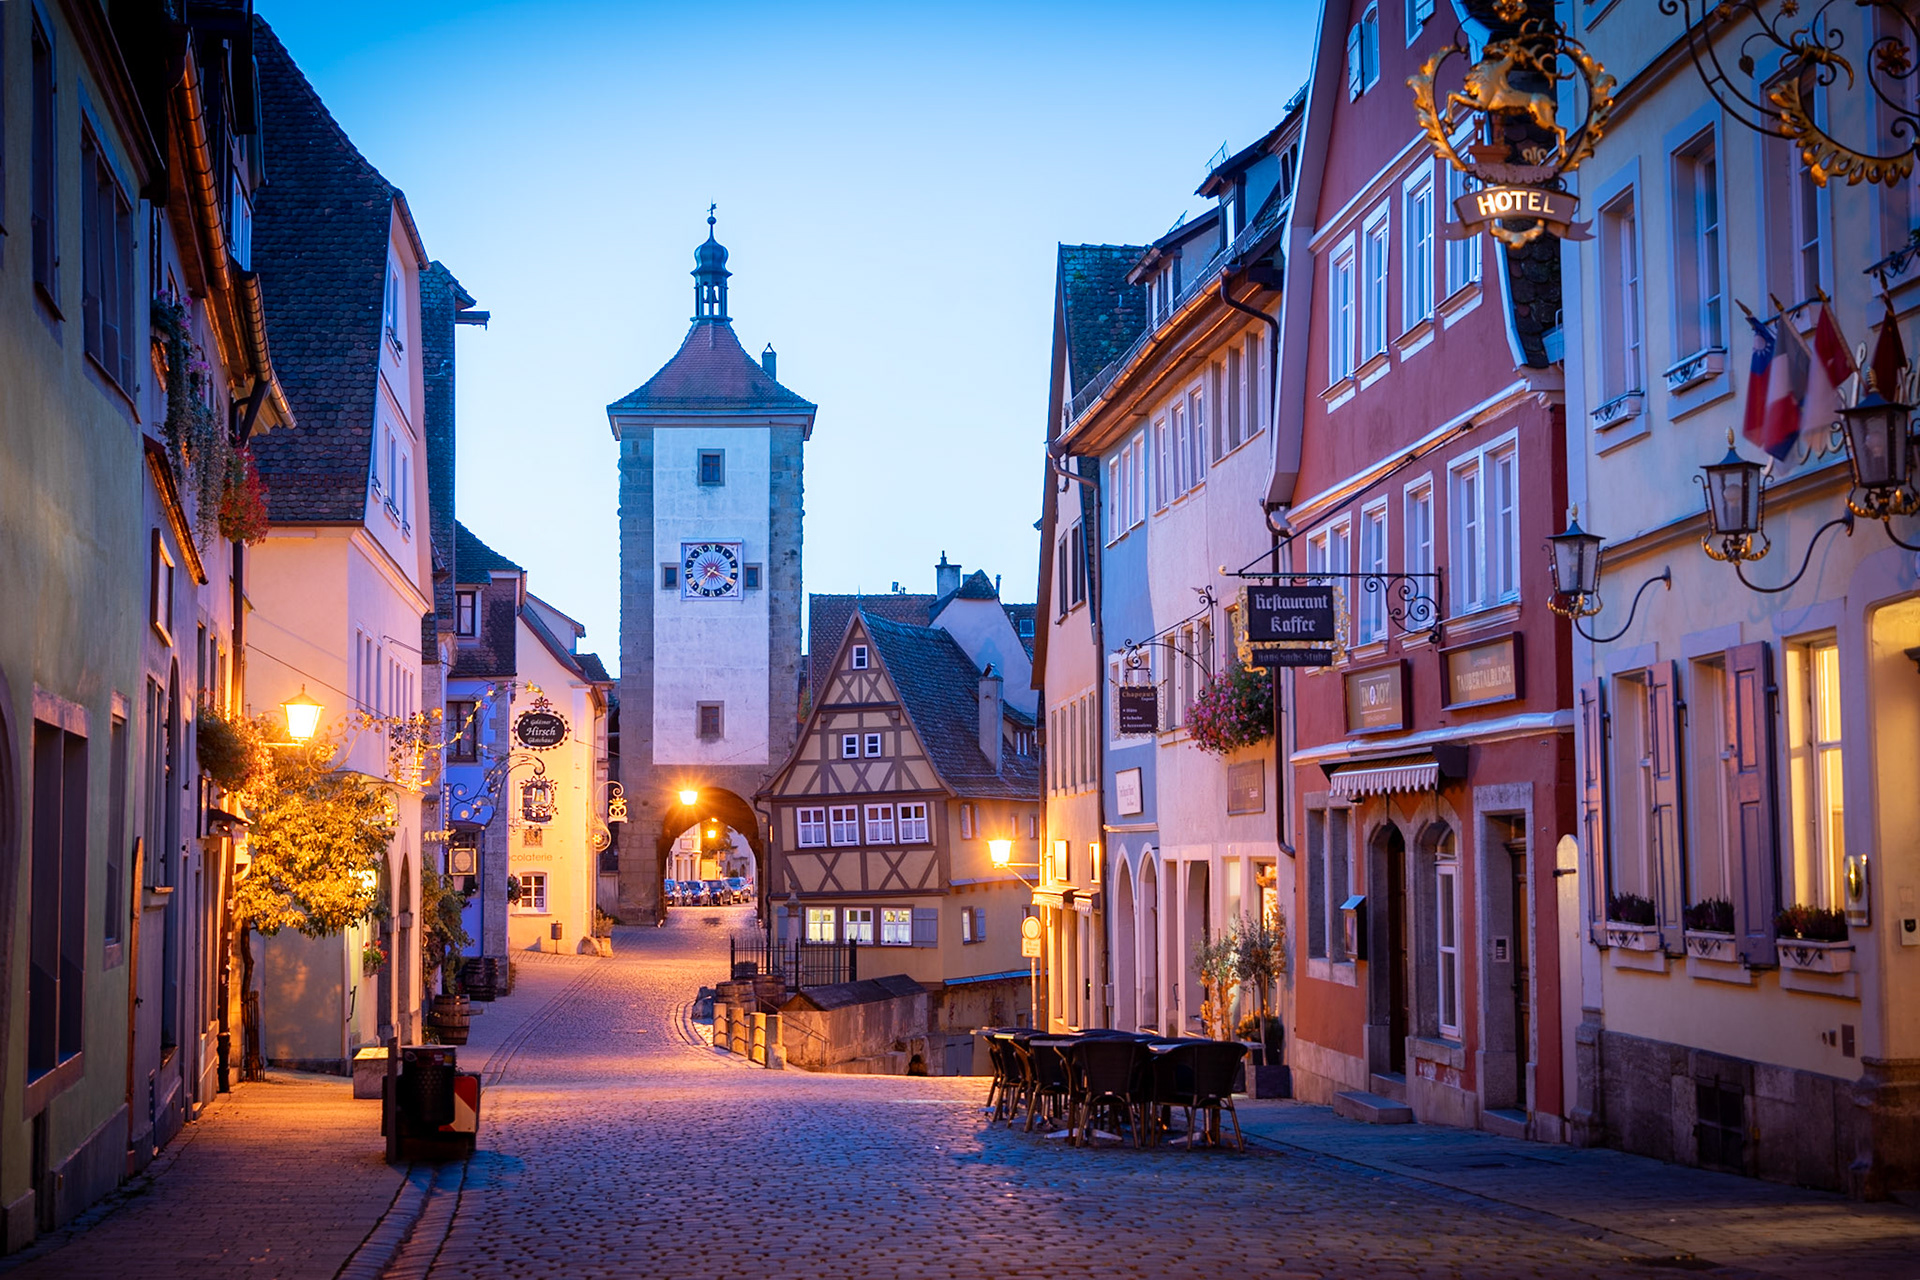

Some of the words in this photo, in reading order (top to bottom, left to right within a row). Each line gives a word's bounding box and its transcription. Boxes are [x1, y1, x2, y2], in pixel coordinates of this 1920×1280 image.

[1477, 191, 1555, 216] HOTEL
[1255, 594, 1328, 611] Restaurant
[1271, 616, 1316, 633] Kaffee
[525, 725, 556, 736] Hirsch
